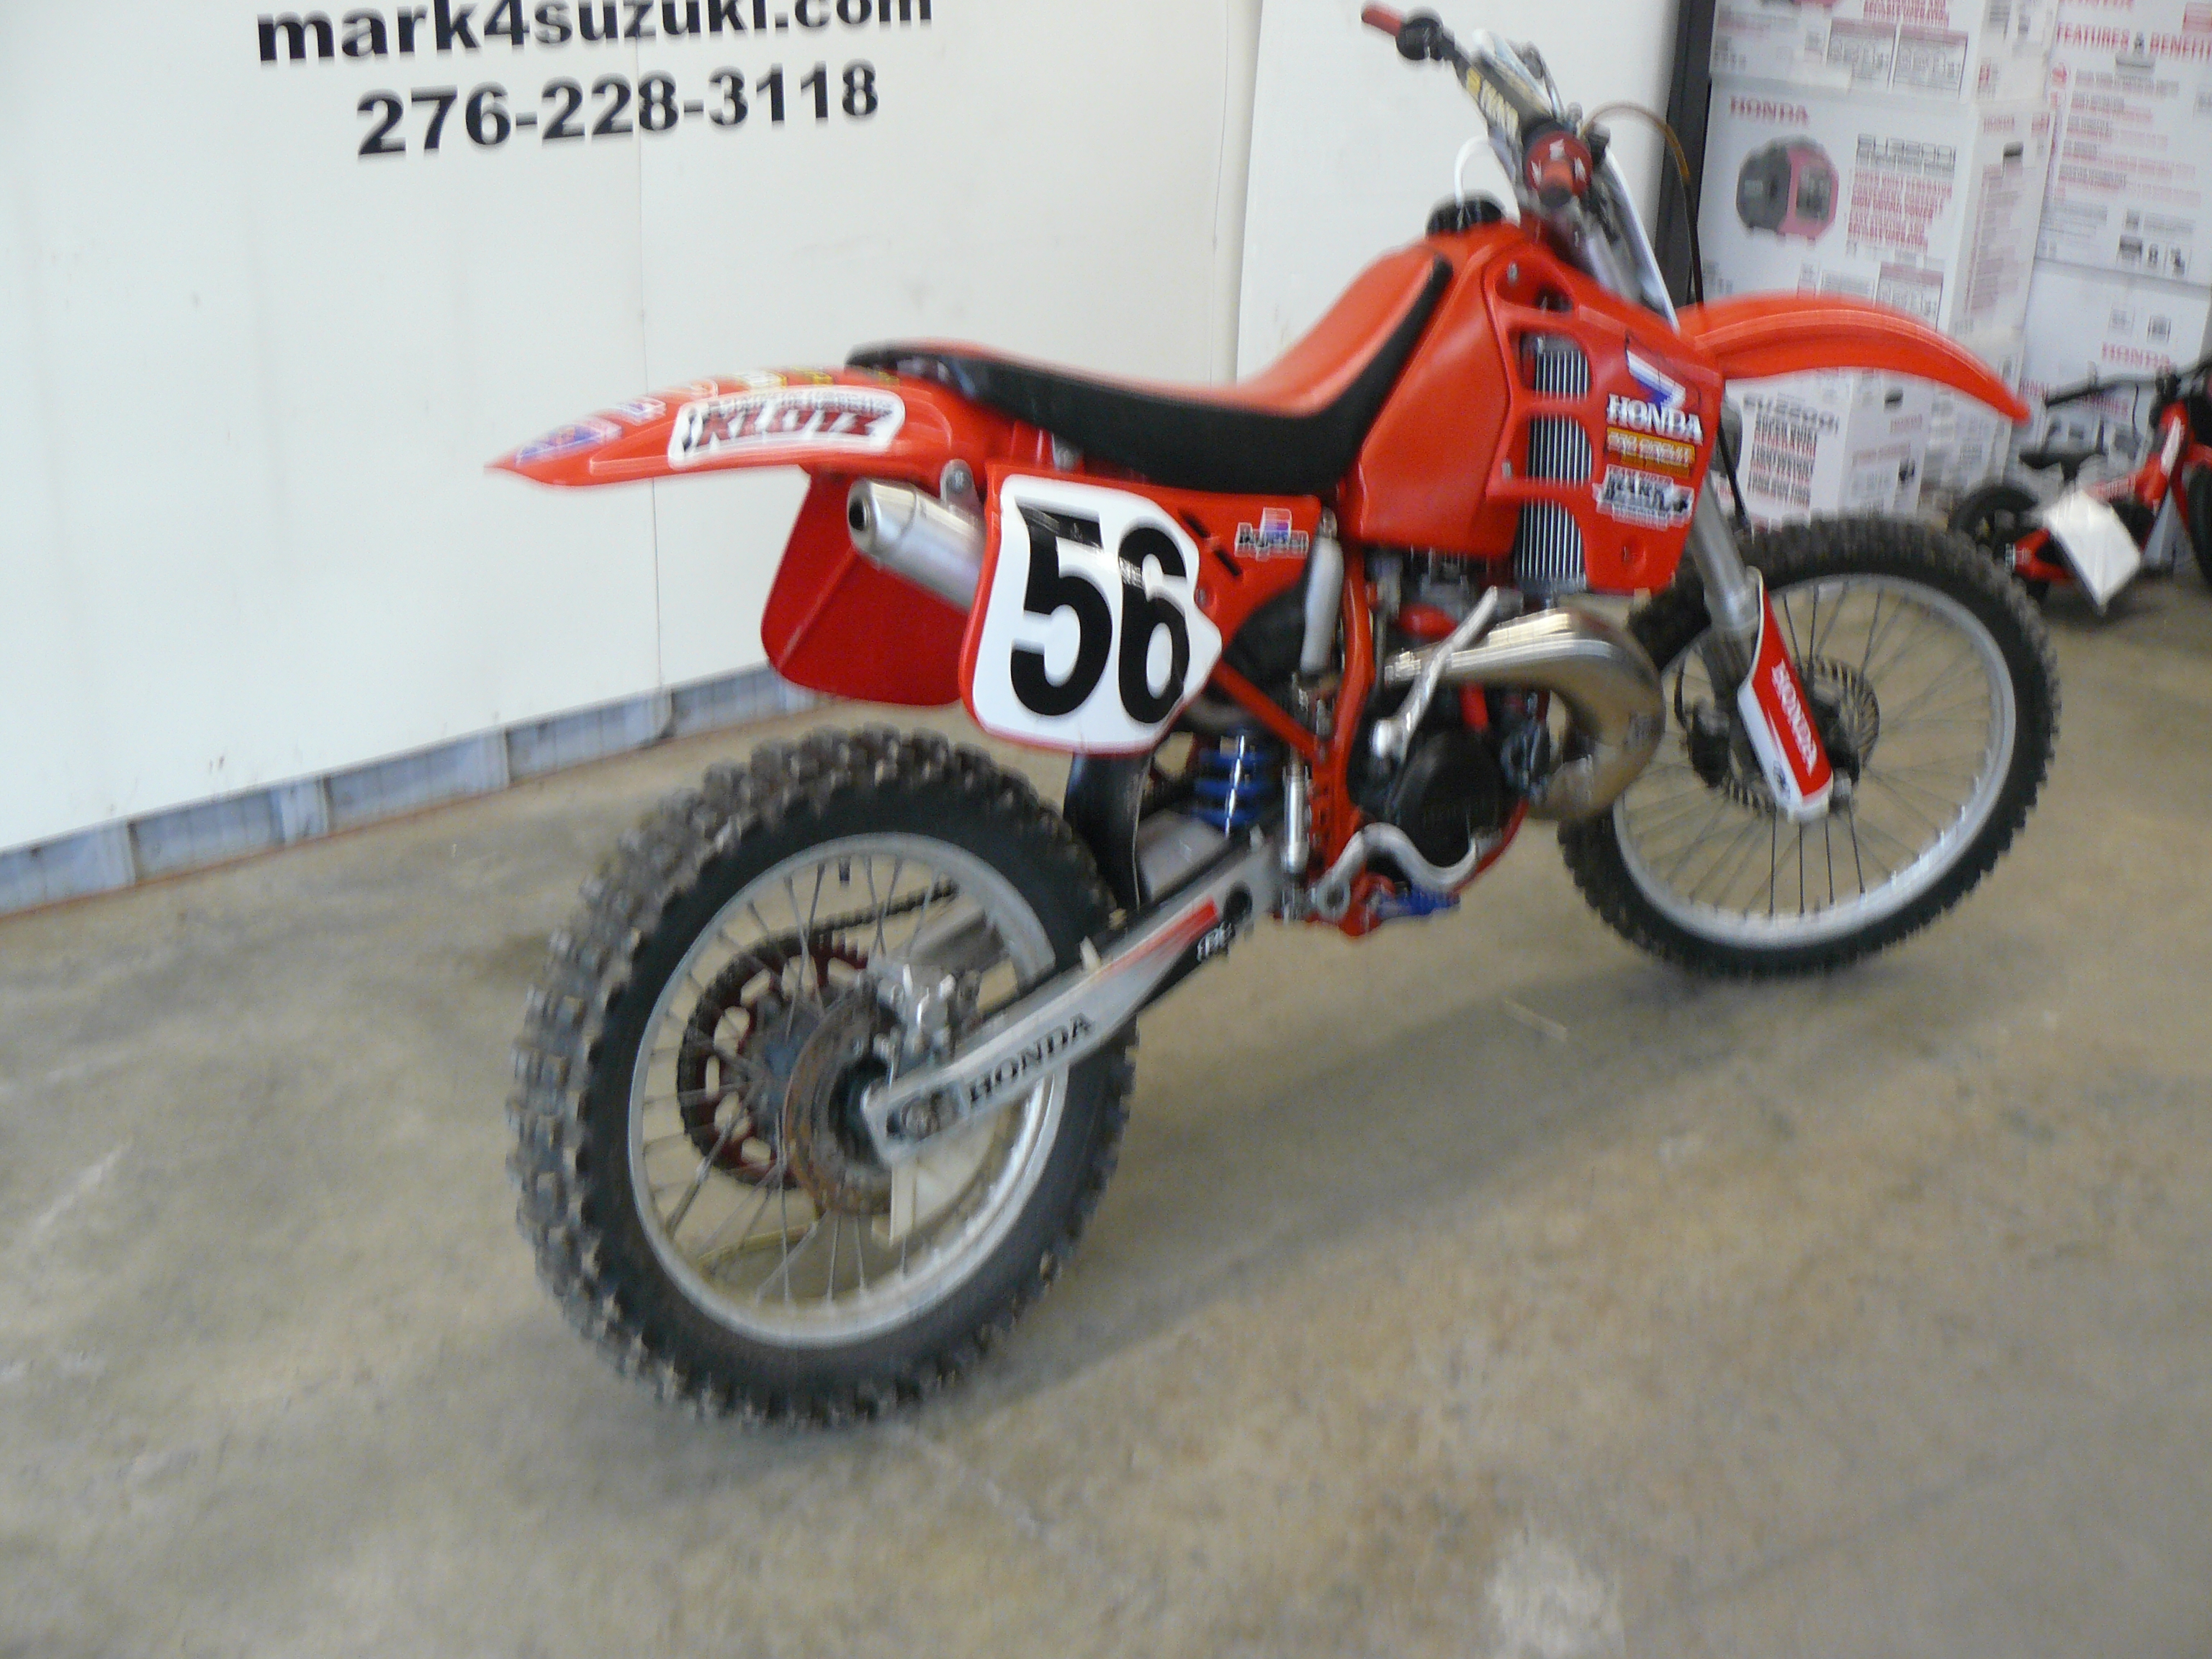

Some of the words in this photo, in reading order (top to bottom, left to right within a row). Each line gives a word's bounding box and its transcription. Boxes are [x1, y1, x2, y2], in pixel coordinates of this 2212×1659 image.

[256, 0, 934, 65] mark4suzuki.com
[357, 60, 879, 158] 276-228-3118
[1730, 95, 1809, 125] HONDA
[1606, 393, 1704, 446] HONDA
[1010, 495, 1191, 724] 56
[969, 1012, 1094, 1102] HONDA
